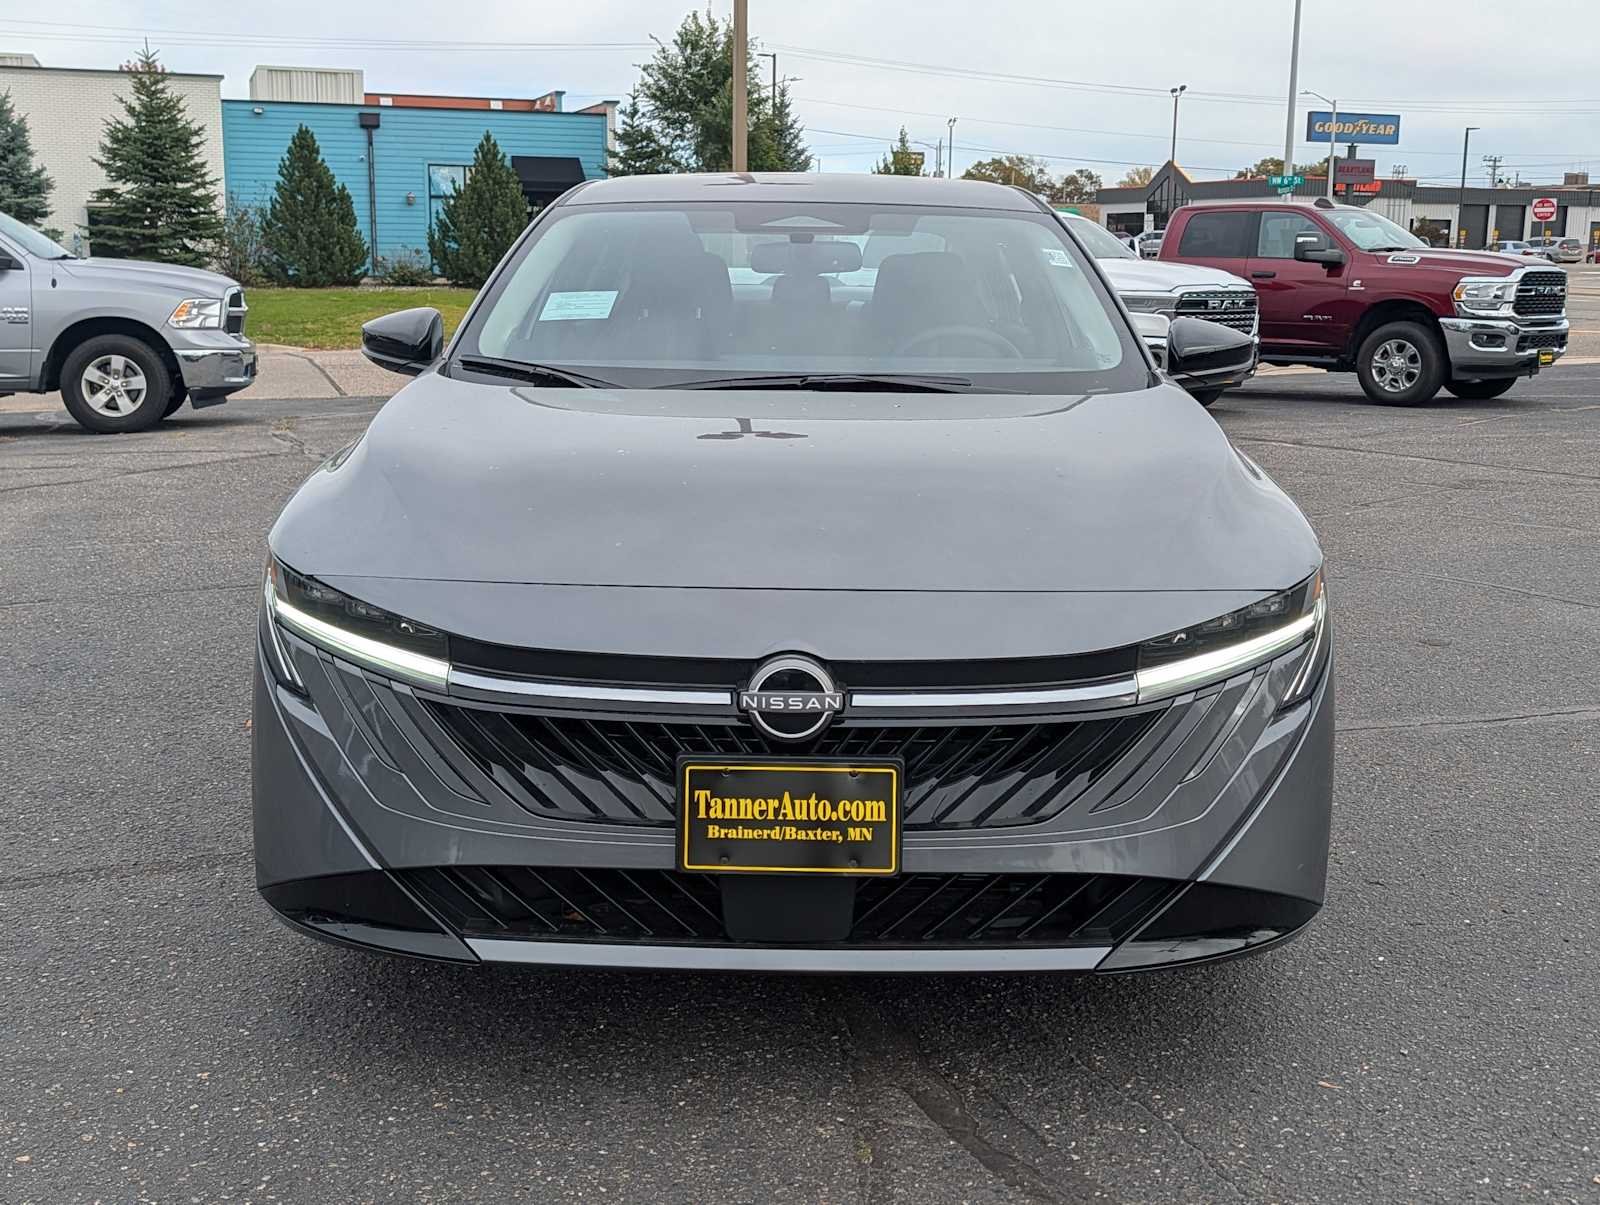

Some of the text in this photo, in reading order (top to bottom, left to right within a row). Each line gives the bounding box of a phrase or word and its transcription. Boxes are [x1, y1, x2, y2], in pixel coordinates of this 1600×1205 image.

[1314, 120, 1396, 136] GOODYEAR
[742, 695, 841, 710] NISSAN
[694, 790, 887, 822] TannerAuto.com
[707, 825, 873, 843] Brainerd/Baxter, MN
